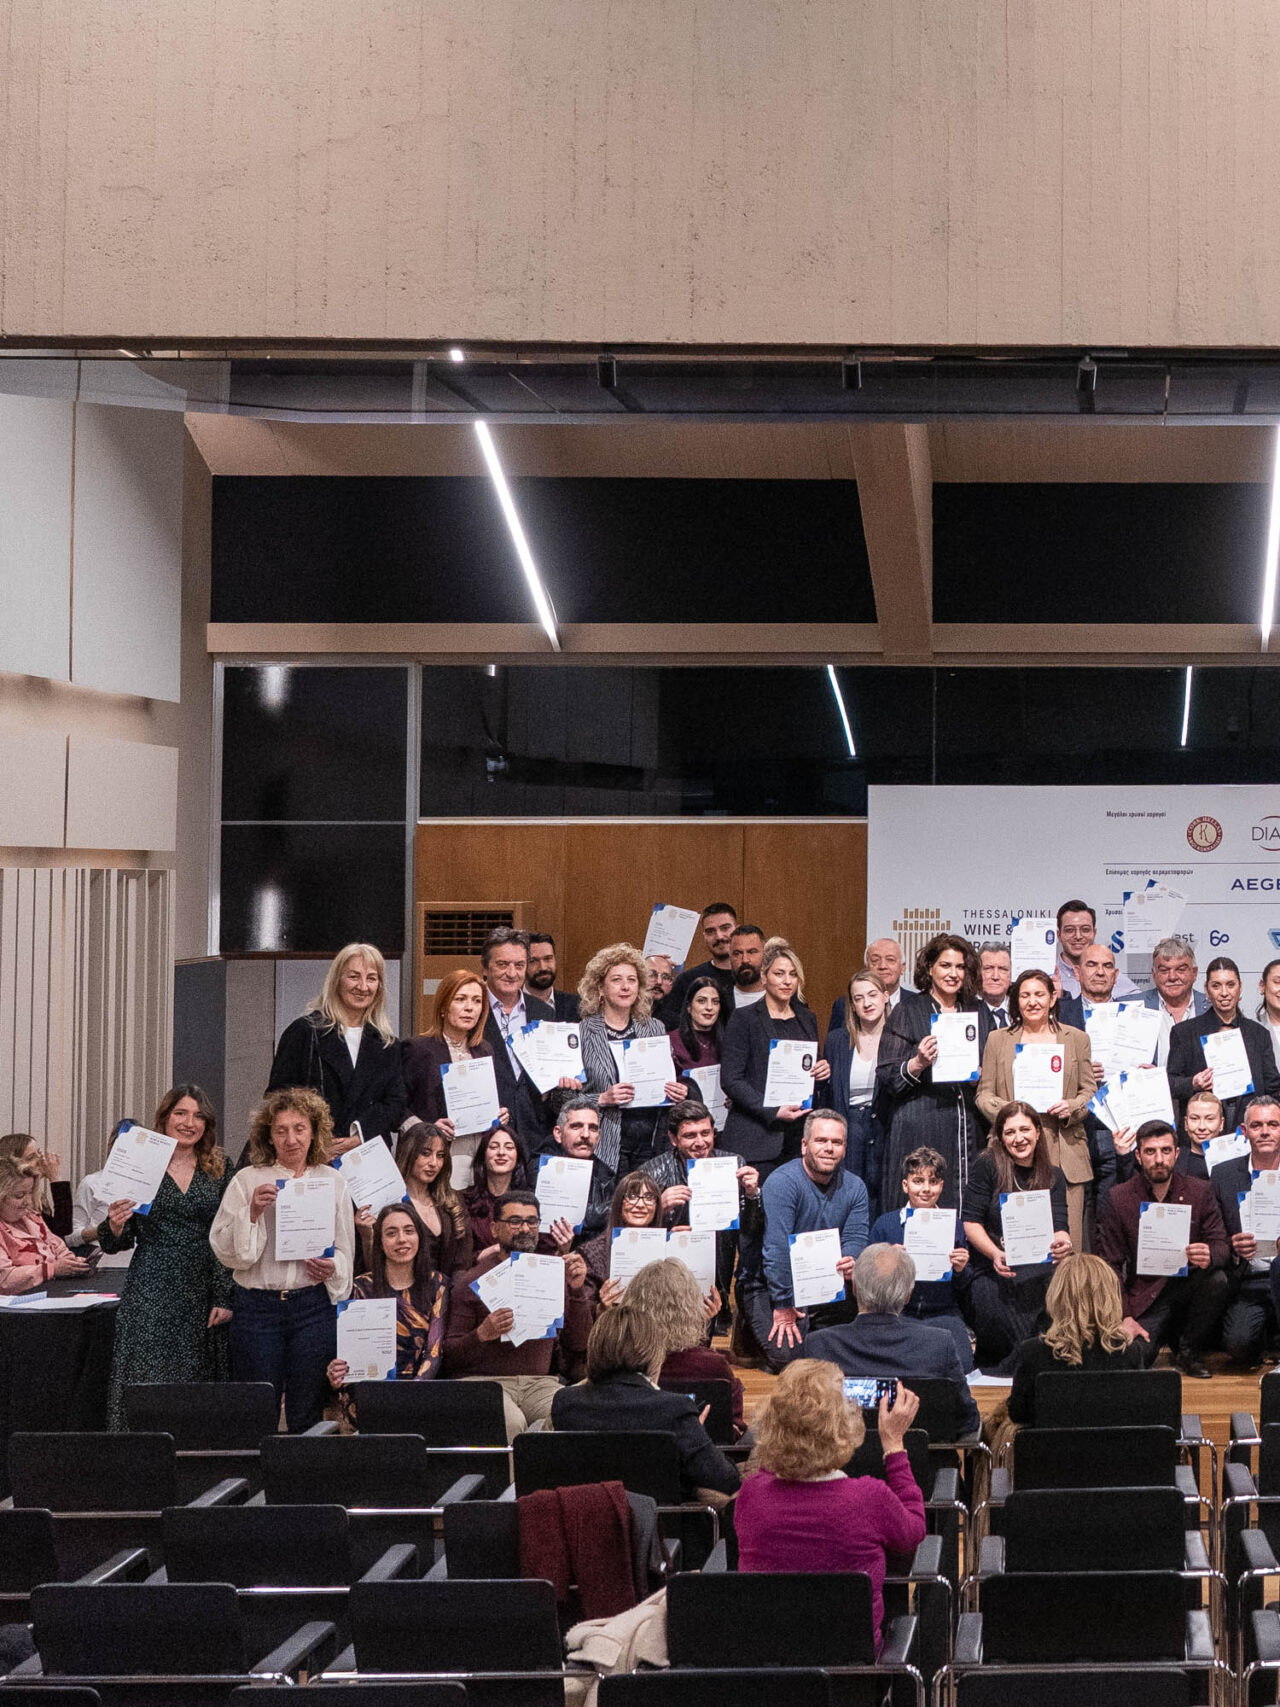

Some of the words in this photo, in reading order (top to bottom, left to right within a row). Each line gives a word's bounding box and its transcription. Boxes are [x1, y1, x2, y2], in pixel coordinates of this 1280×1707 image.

[963, 909, 1051, 918] THESSALONIKI
[964, 924, 1001, 935] WINE
[1005, 924, 1013, 935] &
